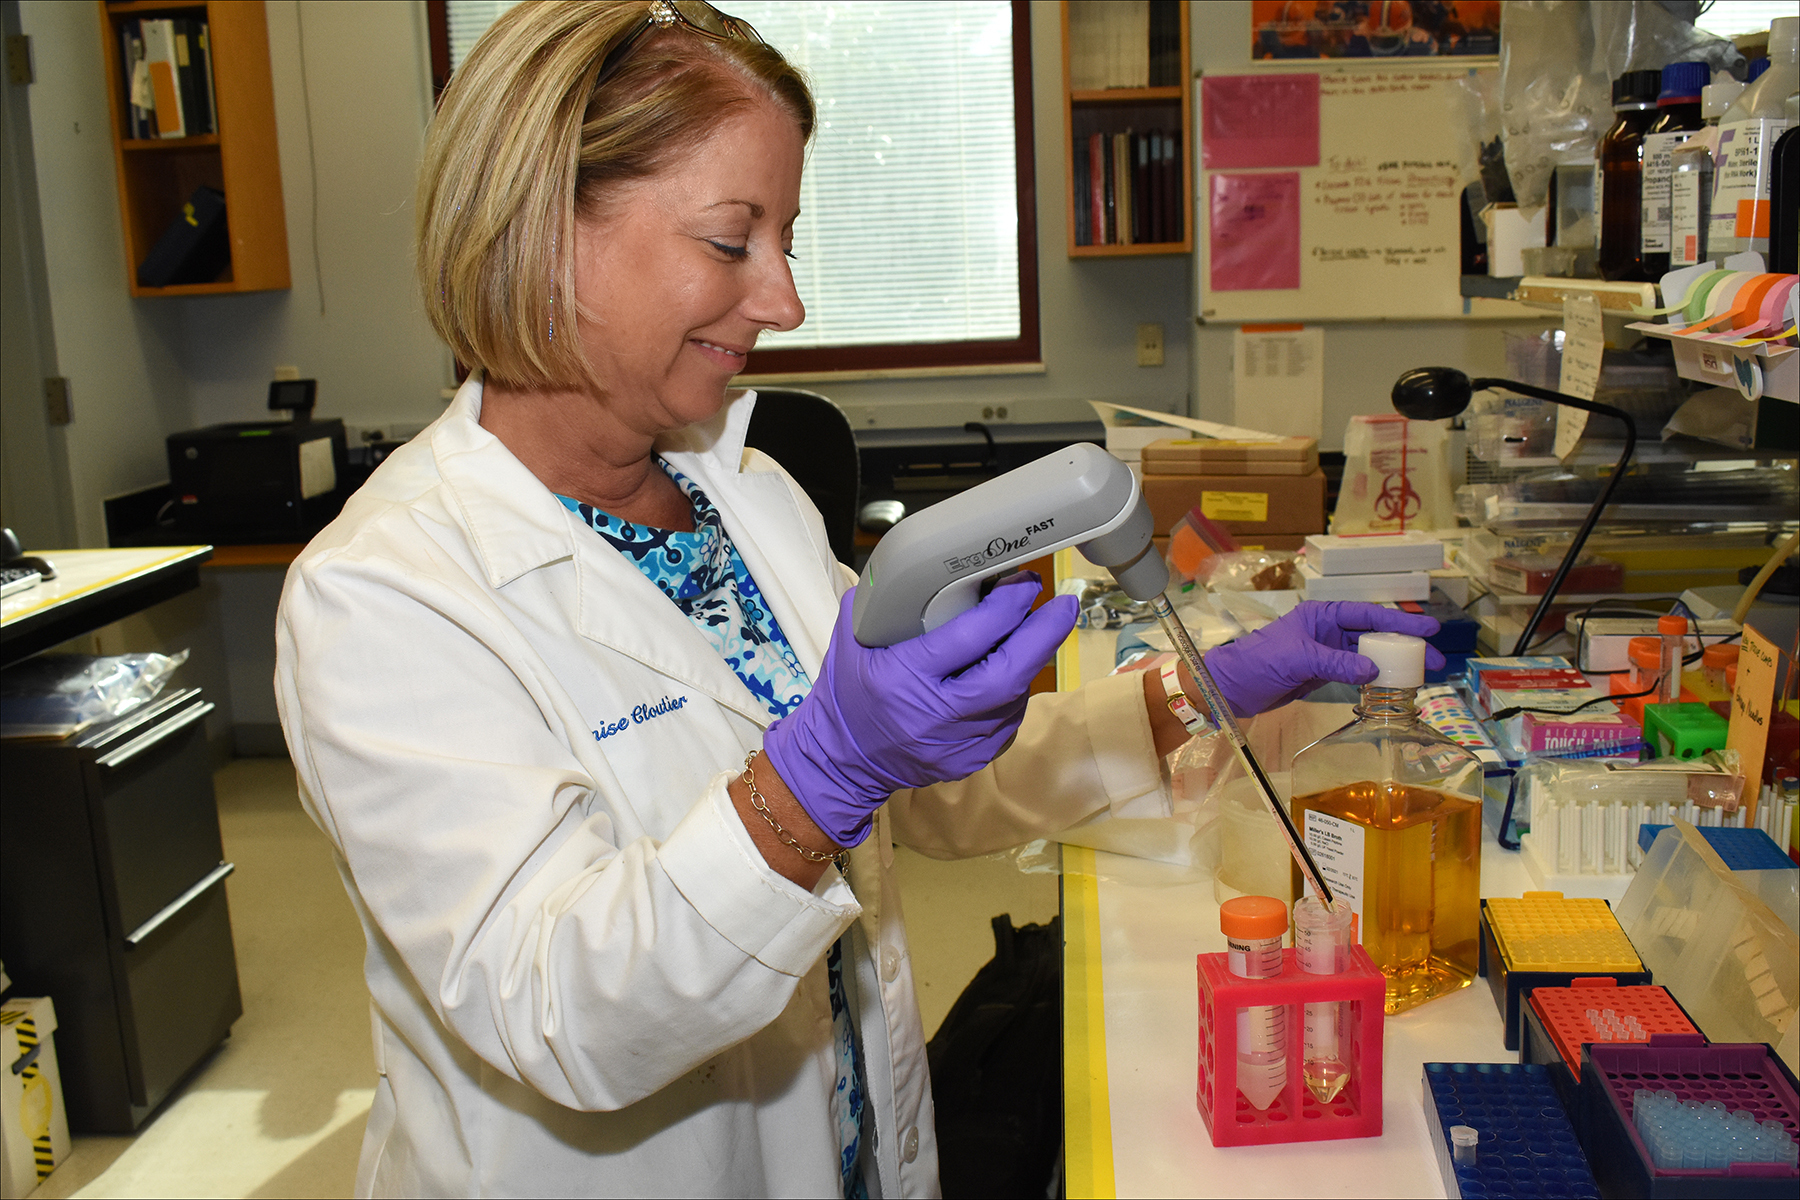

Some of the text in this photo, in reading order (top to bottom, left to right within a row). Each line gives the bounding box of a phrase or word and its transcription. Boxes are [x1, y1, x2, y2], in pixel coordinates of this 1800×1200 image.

[1025, 518, 1055, 535] FAST
[630, 695, 688, 725] Cloutier
[1545, 728, 1623, 739] MICROTUBE
[1309, 826, 1324, 835] Miller's
[1331, 832, 1343, 841] Broth
